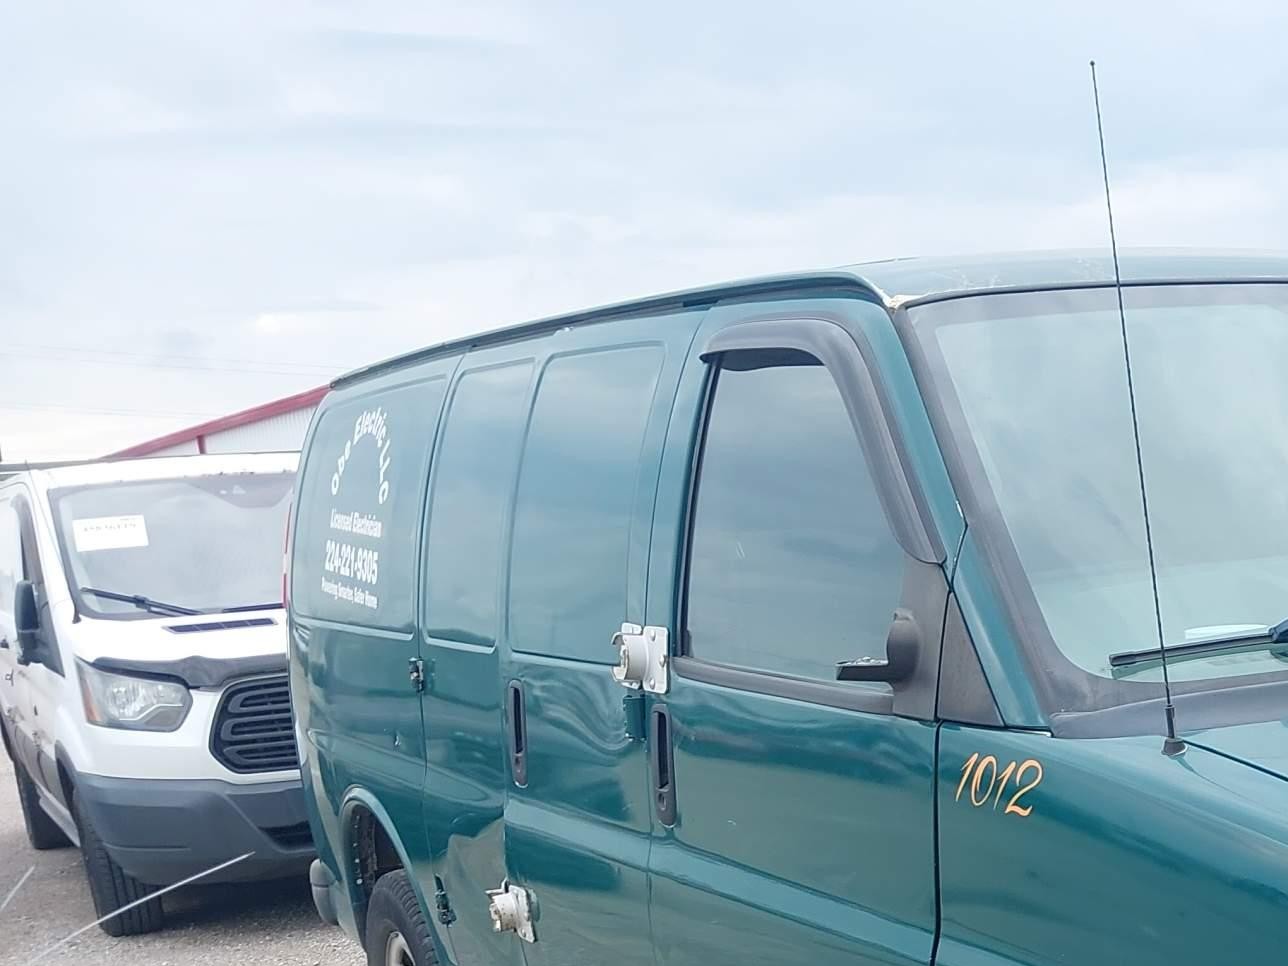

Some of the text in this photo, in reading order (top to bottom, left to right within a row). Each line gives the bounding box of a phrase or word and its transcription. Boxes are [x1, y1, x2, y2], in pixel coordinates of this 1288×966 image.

[353, 407, 387, 448] Electric
[325, 539, 378, 585] 224-221-9305
[955, 752, 1043, 817] 1012
